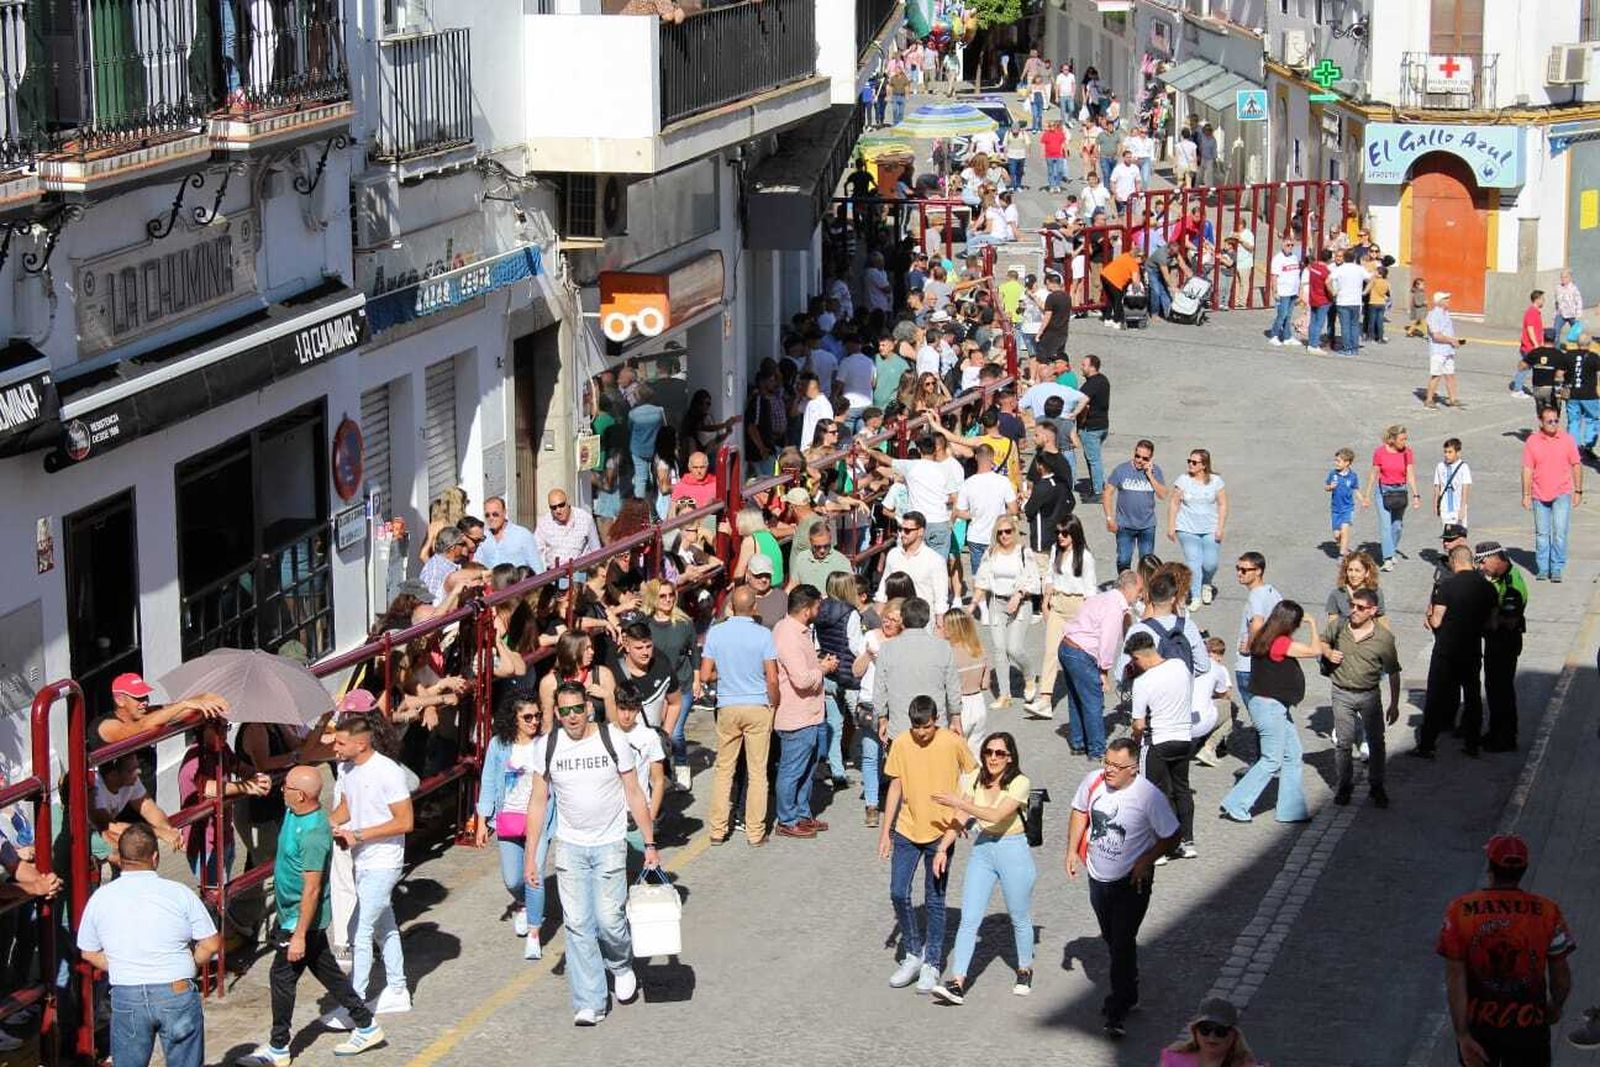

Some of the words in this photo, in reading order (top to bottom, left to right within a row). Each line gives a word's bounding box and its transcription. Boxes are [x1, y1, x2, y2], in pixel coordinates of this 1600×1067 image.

[1368, 138, 1393, 168] El
[1398, 129, 1454, 152] Gallo
[1462, 131, 1513, 168] Azul
[556, 755, 609, 772] HILFIGER
